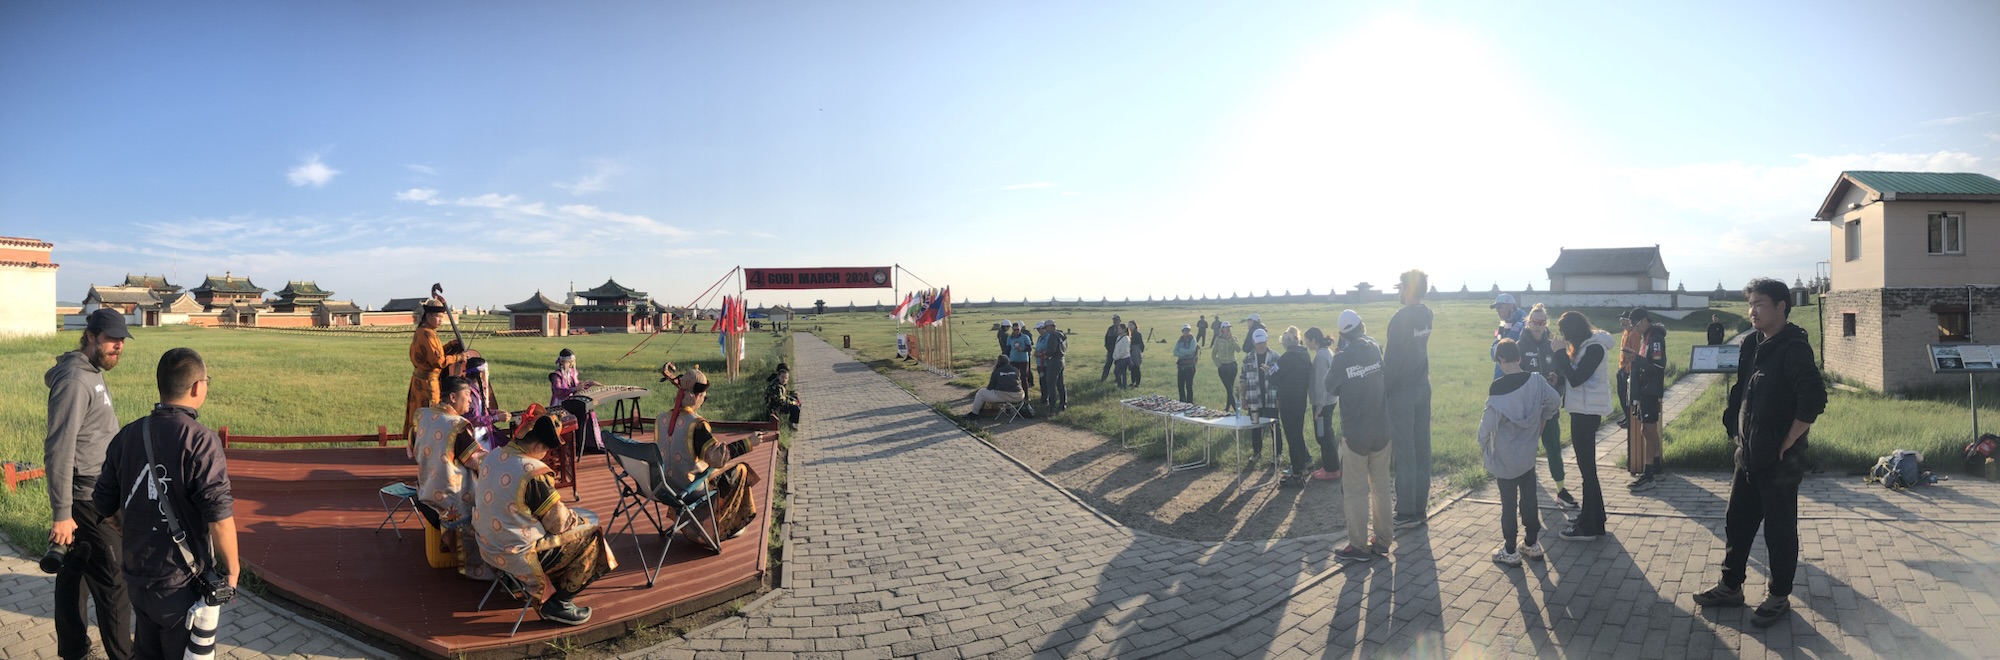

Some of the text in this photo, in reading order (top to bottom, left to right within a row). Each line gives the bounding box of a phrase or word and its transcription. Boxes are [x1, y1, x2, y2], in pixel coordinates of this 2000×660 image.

[749, 271, 761, 287] 4
[767, 273, 794, 284] GOBI
[798, 272, 840, 284] MARCH
[845, 272, 870, 283] 2024
